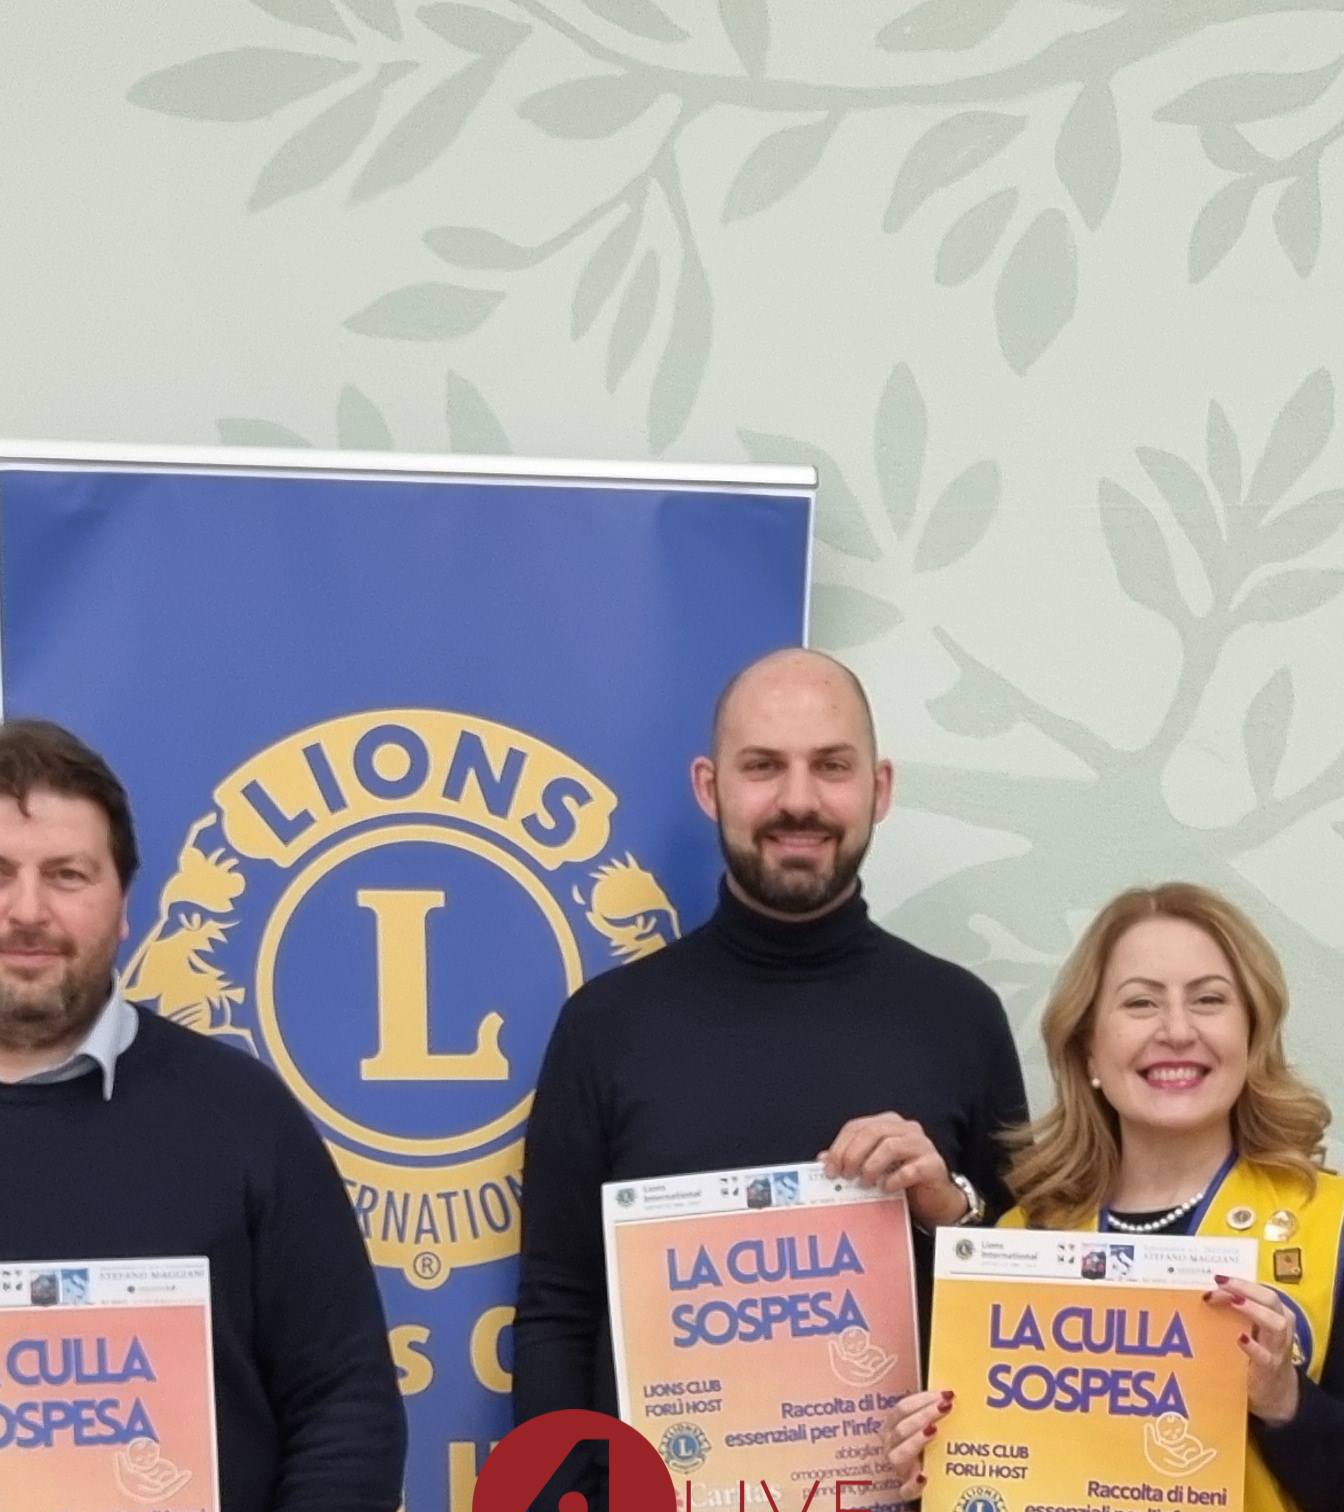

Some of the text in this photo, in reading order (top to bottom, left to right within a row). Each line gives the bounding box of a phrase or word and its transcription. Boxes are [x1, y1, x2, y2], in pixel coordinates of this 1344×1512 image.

[240, 723, 595, 846] LIONS
[356, 890, 510, 1081] L
[665, 1230, 867, 1291] LA CULLA
[669, 1288, 870, 1347] SOSPESA
[990, 1304, 1194, 1358] LA CULLA
[4, 1336, 158, 1386] CULLA
[642, 1379, 722, 1397] LIONS CLUB
[781, 1393, 873, 1418] Raccolta di
[987, 1363, 1190, 1419] SOSPESA
[644, 1397, 723, 1417] FORLÌ HOST
[724, 1424, 840, 1447] essenziali per
[946, 1441, 1029, 1459] LIONS CLUB
[945, 1460, 1028, 1479] FORLÌ HOST
[1087, 1480, 1225, 1505] Raccolta di beni
